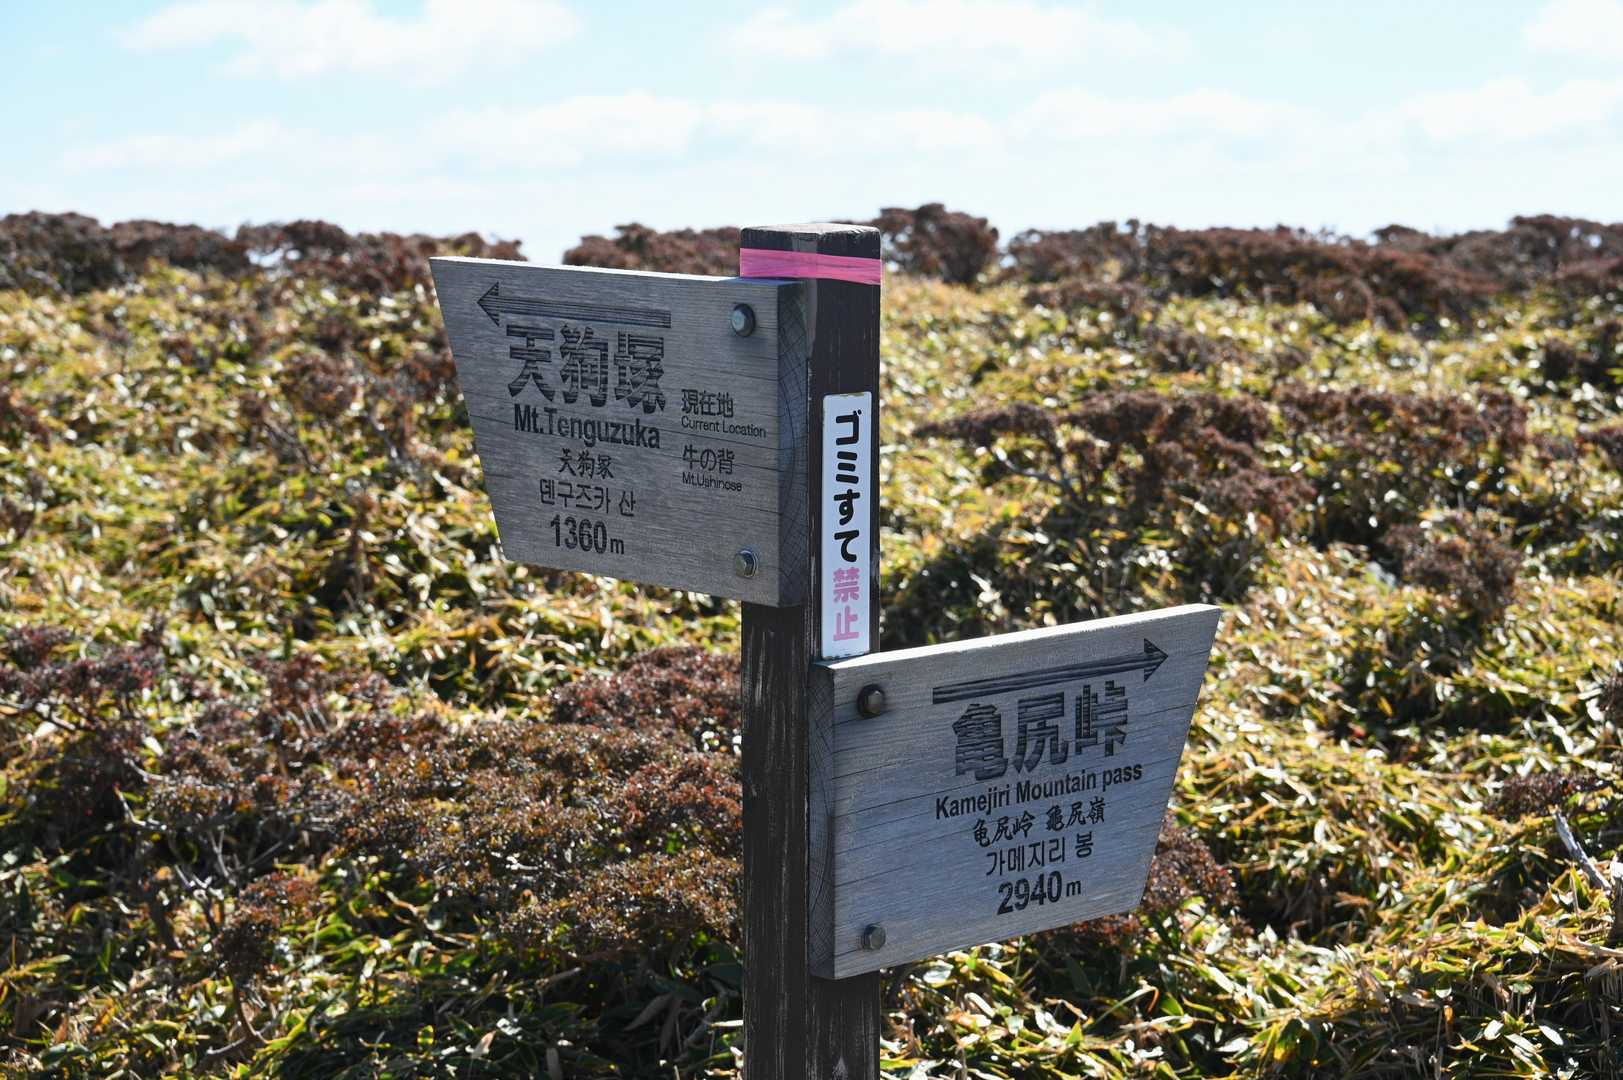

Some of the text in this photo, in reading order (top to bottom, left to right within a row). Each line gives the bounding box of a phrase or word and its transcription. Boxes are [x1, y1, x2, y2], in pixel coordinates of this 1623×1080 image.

[507, 324, 666, 414] 天狗塚
[681, 389, 734, 418] 現在地
[514, 404, 660, 448] Mt.Tenguzuka
[681, 416, 766, 438] Current Location
[683, 444, 735, 475] 牛の背
[619, 491, 636, 517] 산
[833, 410, 863, 641] ゴミすて禁止
[952, 680, 1129, 781] 亀尻峠
[936, 761, 1143, 820] Kamejiri Mountain pass
[986, 831, 1094, 876] 가메지리 봉
